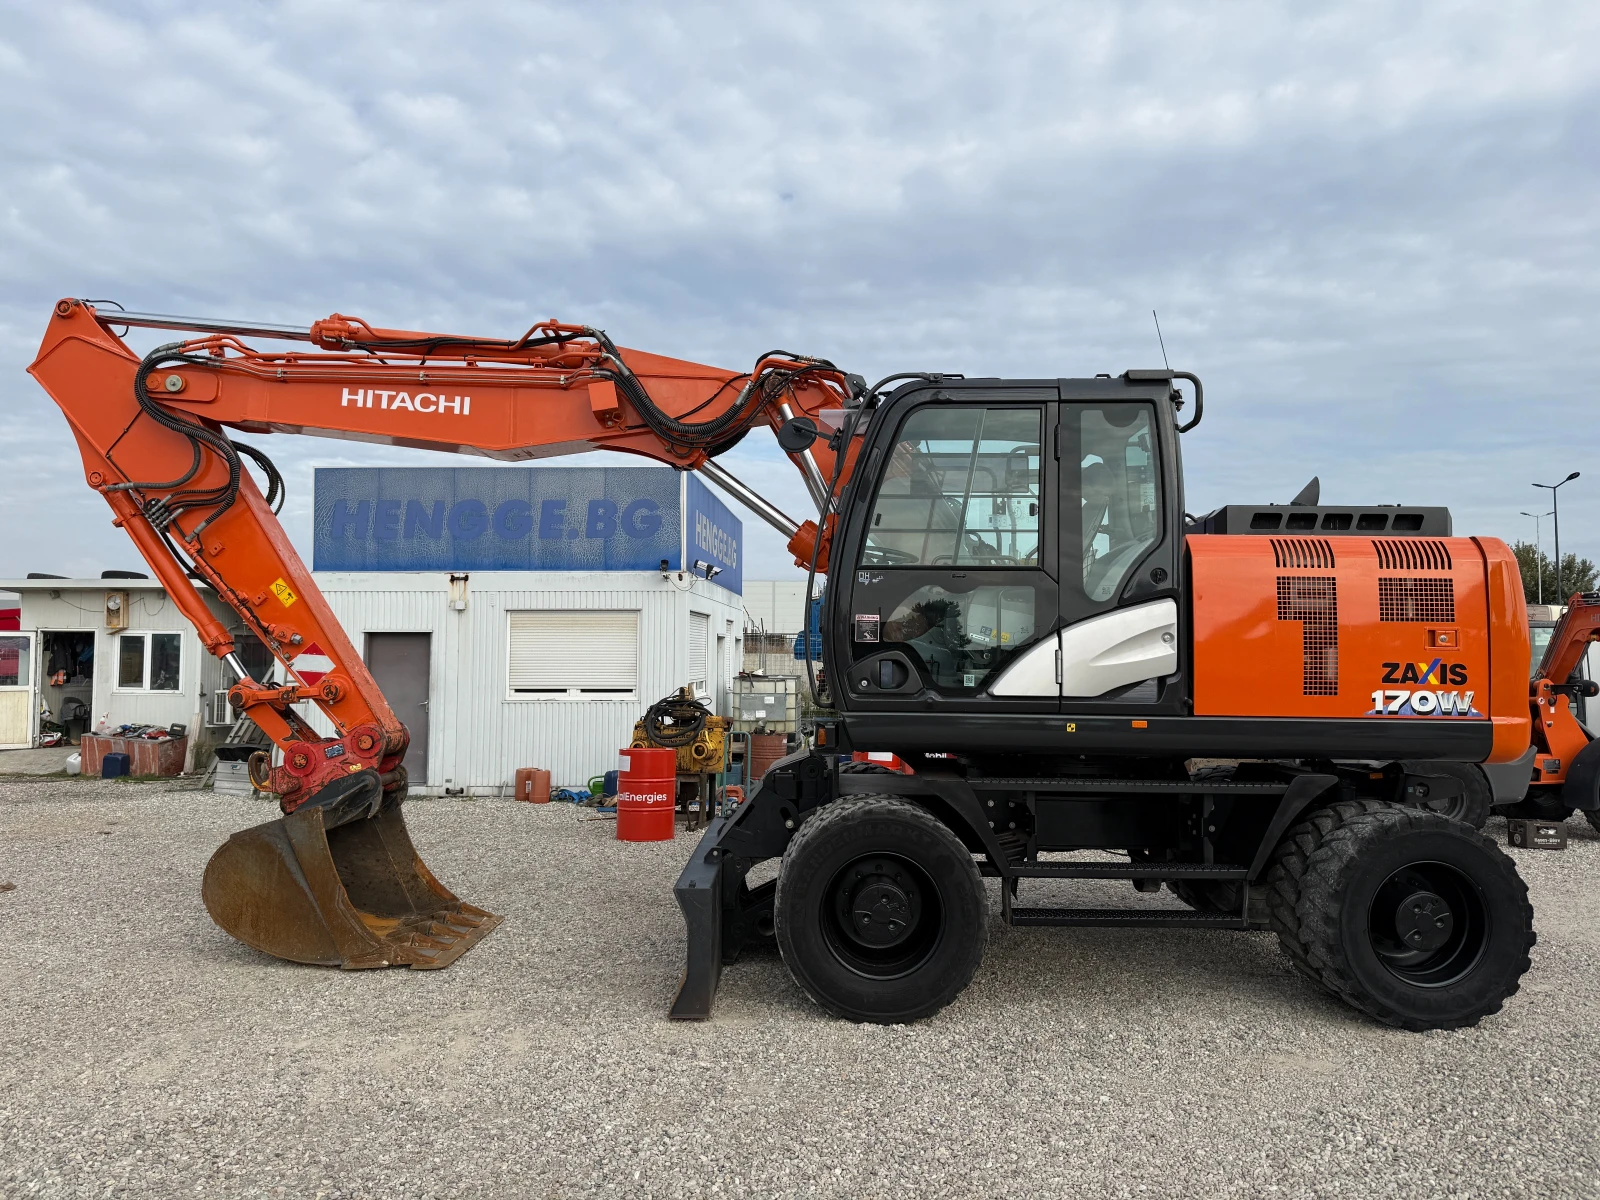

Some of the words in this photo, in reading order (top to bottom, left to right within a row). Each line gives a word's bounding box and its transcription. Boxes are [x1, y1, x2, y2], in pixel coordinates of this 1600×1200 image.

[341, 387, 471, 416] HITACHI
[331, 499, 663, 540] HENGGE.BG
[1381, 658, 1468, 686] ZAXIS
[1371, 690, 1475, 716] 170W
